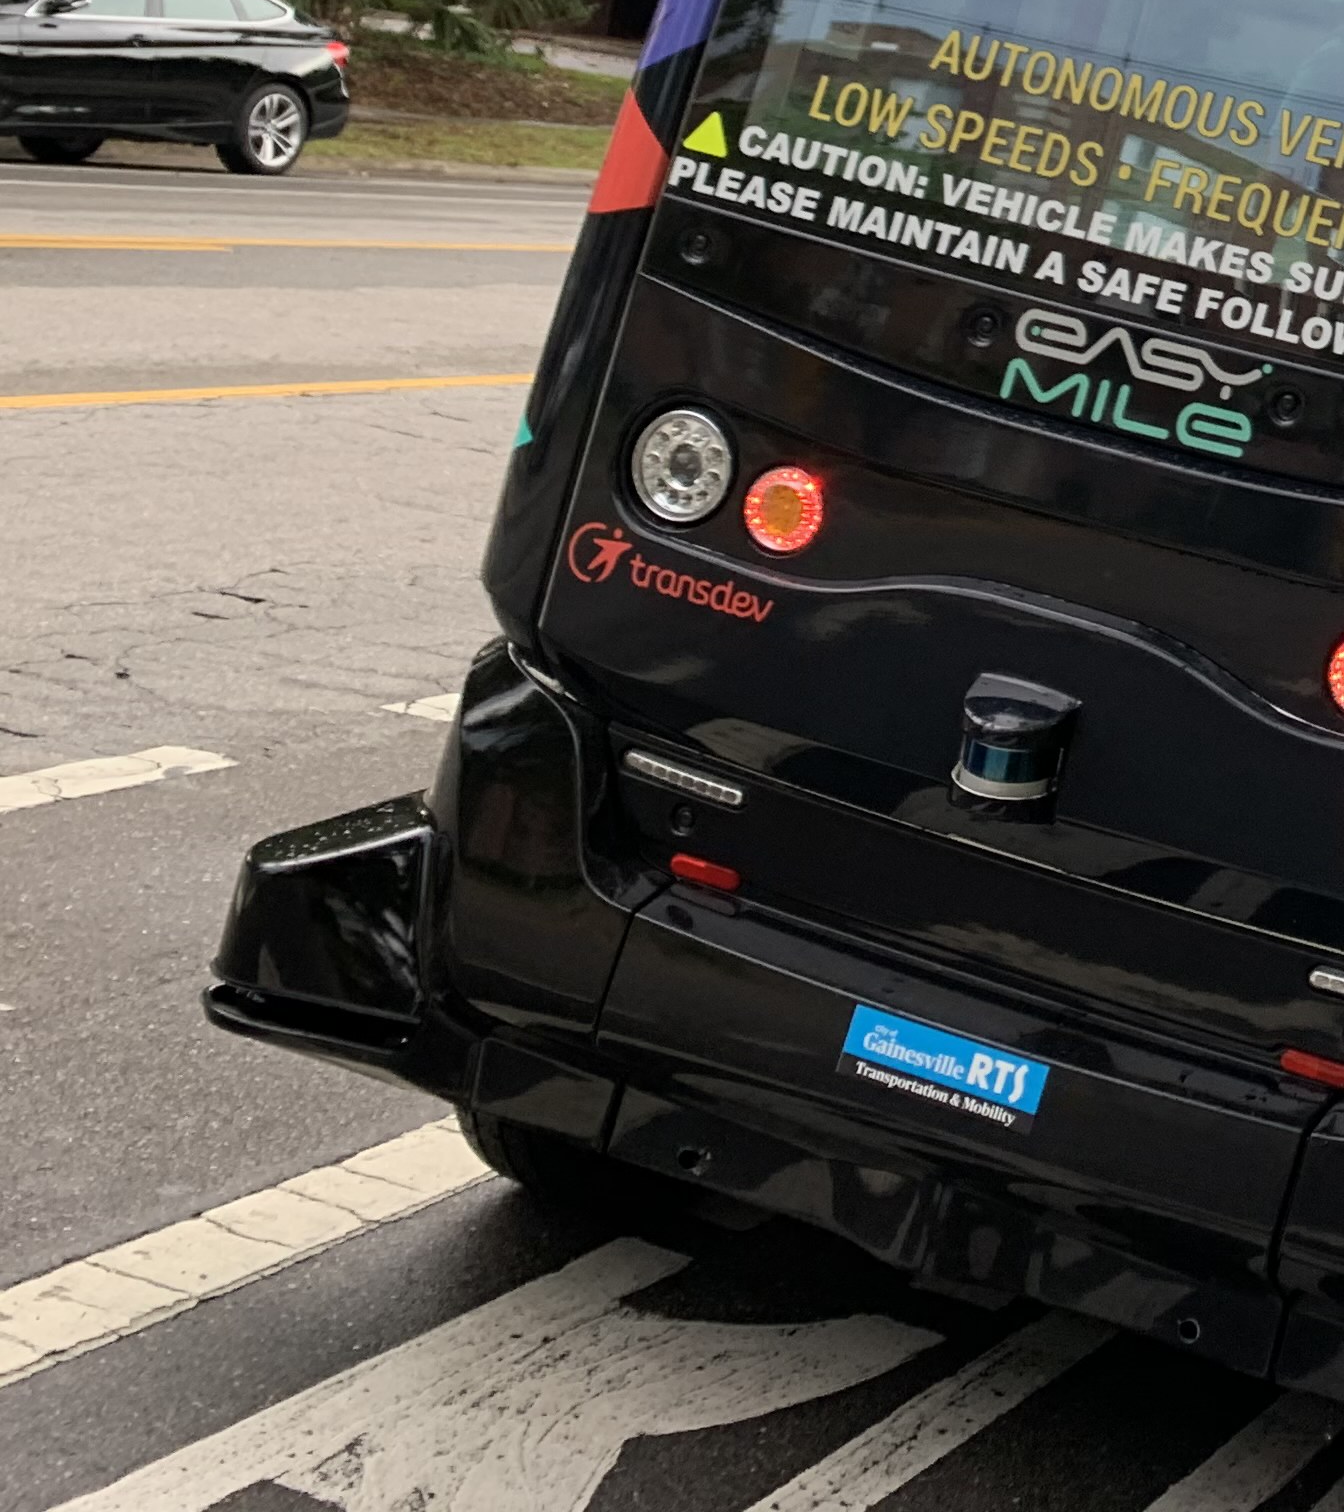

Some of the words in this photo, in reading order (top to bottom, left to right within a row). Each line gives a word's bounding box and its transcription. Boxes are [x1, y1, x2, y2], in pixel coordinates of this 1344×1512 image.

[808, 75, 914, 139] LOW
[920, 103, 1104, 187] SPEEDS
[929, 30, 1264, 146] AUTONOMOUS
[668, 156, 819, 221] PLEASE
[826, 196, 1030, 274] MAINTAIN
[1034, 256, 1064, 285] A
[1077, 260, 1187, 315] SAFE
[738, 125, 929, 199] CAUTION:
[942, 172, 1118, 245] VEHICLE
[1124, 221, 1274, 284] MAKES
[630, 553, 775, 623] transdev
[856, 1060, 953, 1104] Transportation
[950, 1095, 962, 1108] &
[962, 1097, 1016, 1127] Mobility
[863, 1032, 965, 1081] Gainesville
[966, 1052, 1030, 1104] RTS
